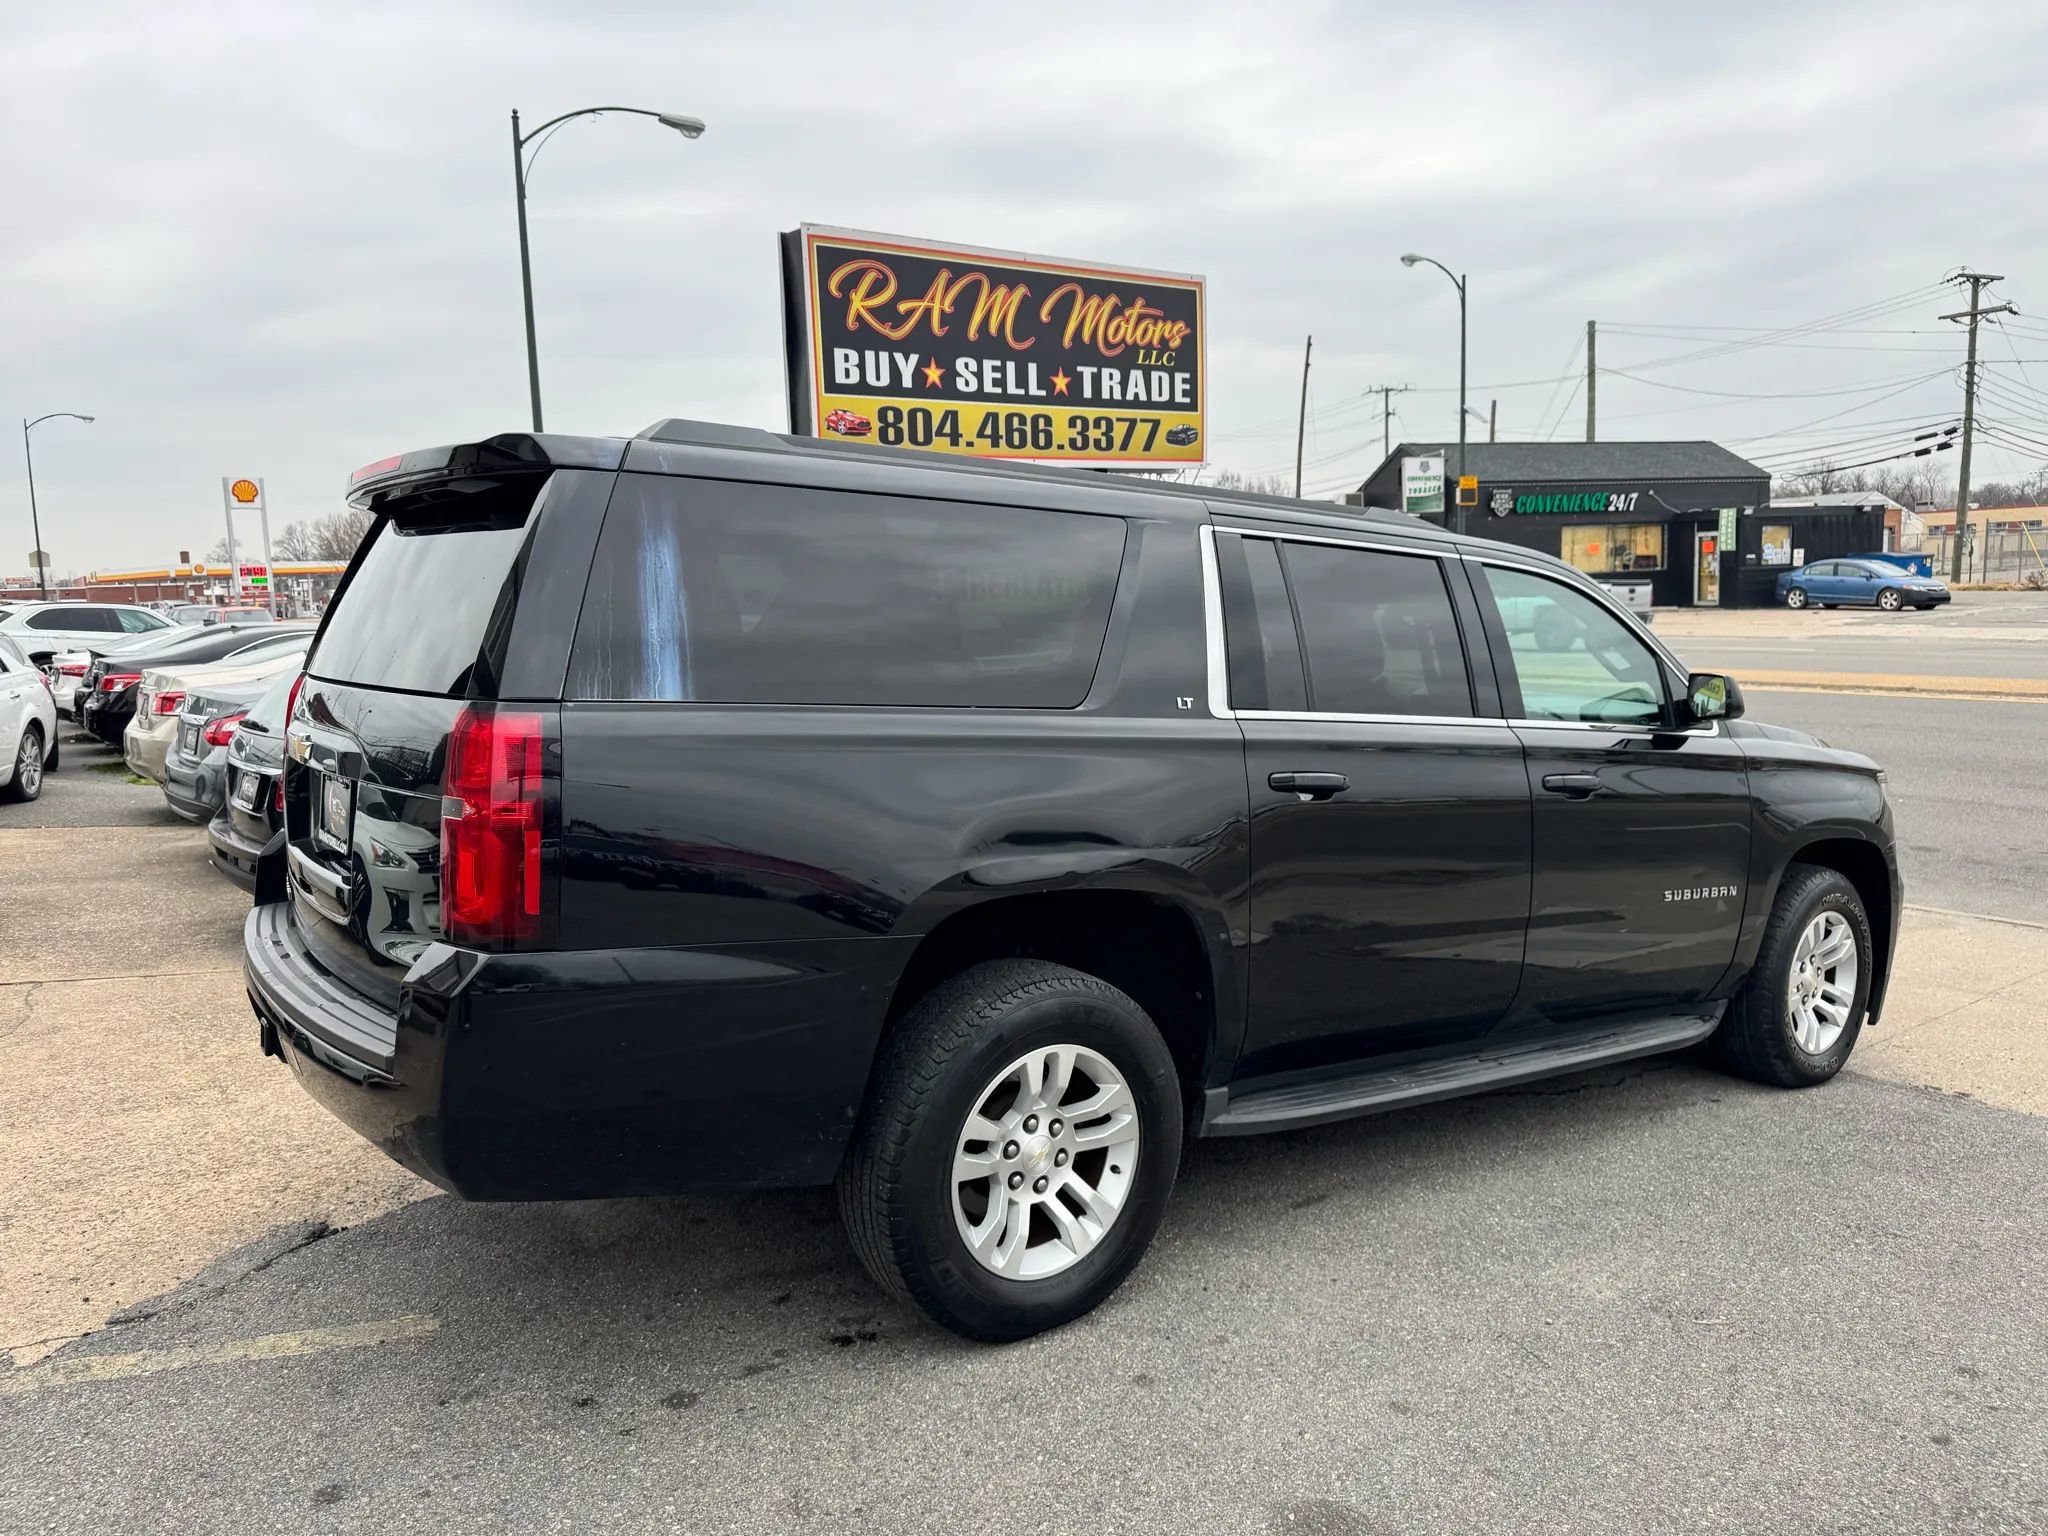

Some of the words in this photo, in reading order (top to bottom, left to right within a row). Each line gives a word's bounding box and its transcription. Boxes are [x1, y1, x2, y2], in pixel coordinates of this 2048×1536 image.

[828, 259, 1035, 350] RAM
[1040, 283, 1191, 357] Motors
[1136, 349, 1175, 367] LLC
[833, 347, 919, 389] BUY
[955, 356, 1046, 397] SELL
[1076, 365, 1191, 403] TRADE
[877, 405, 1161, 452] 804.466.3377
[1515, 492, 1609, 513] CONVENIENCE
[1607, 492, 1639, 511] 24/7
[1176, 696, 1194, 710] LT
[1664, 885, 1737, 902] SUBURBAN
